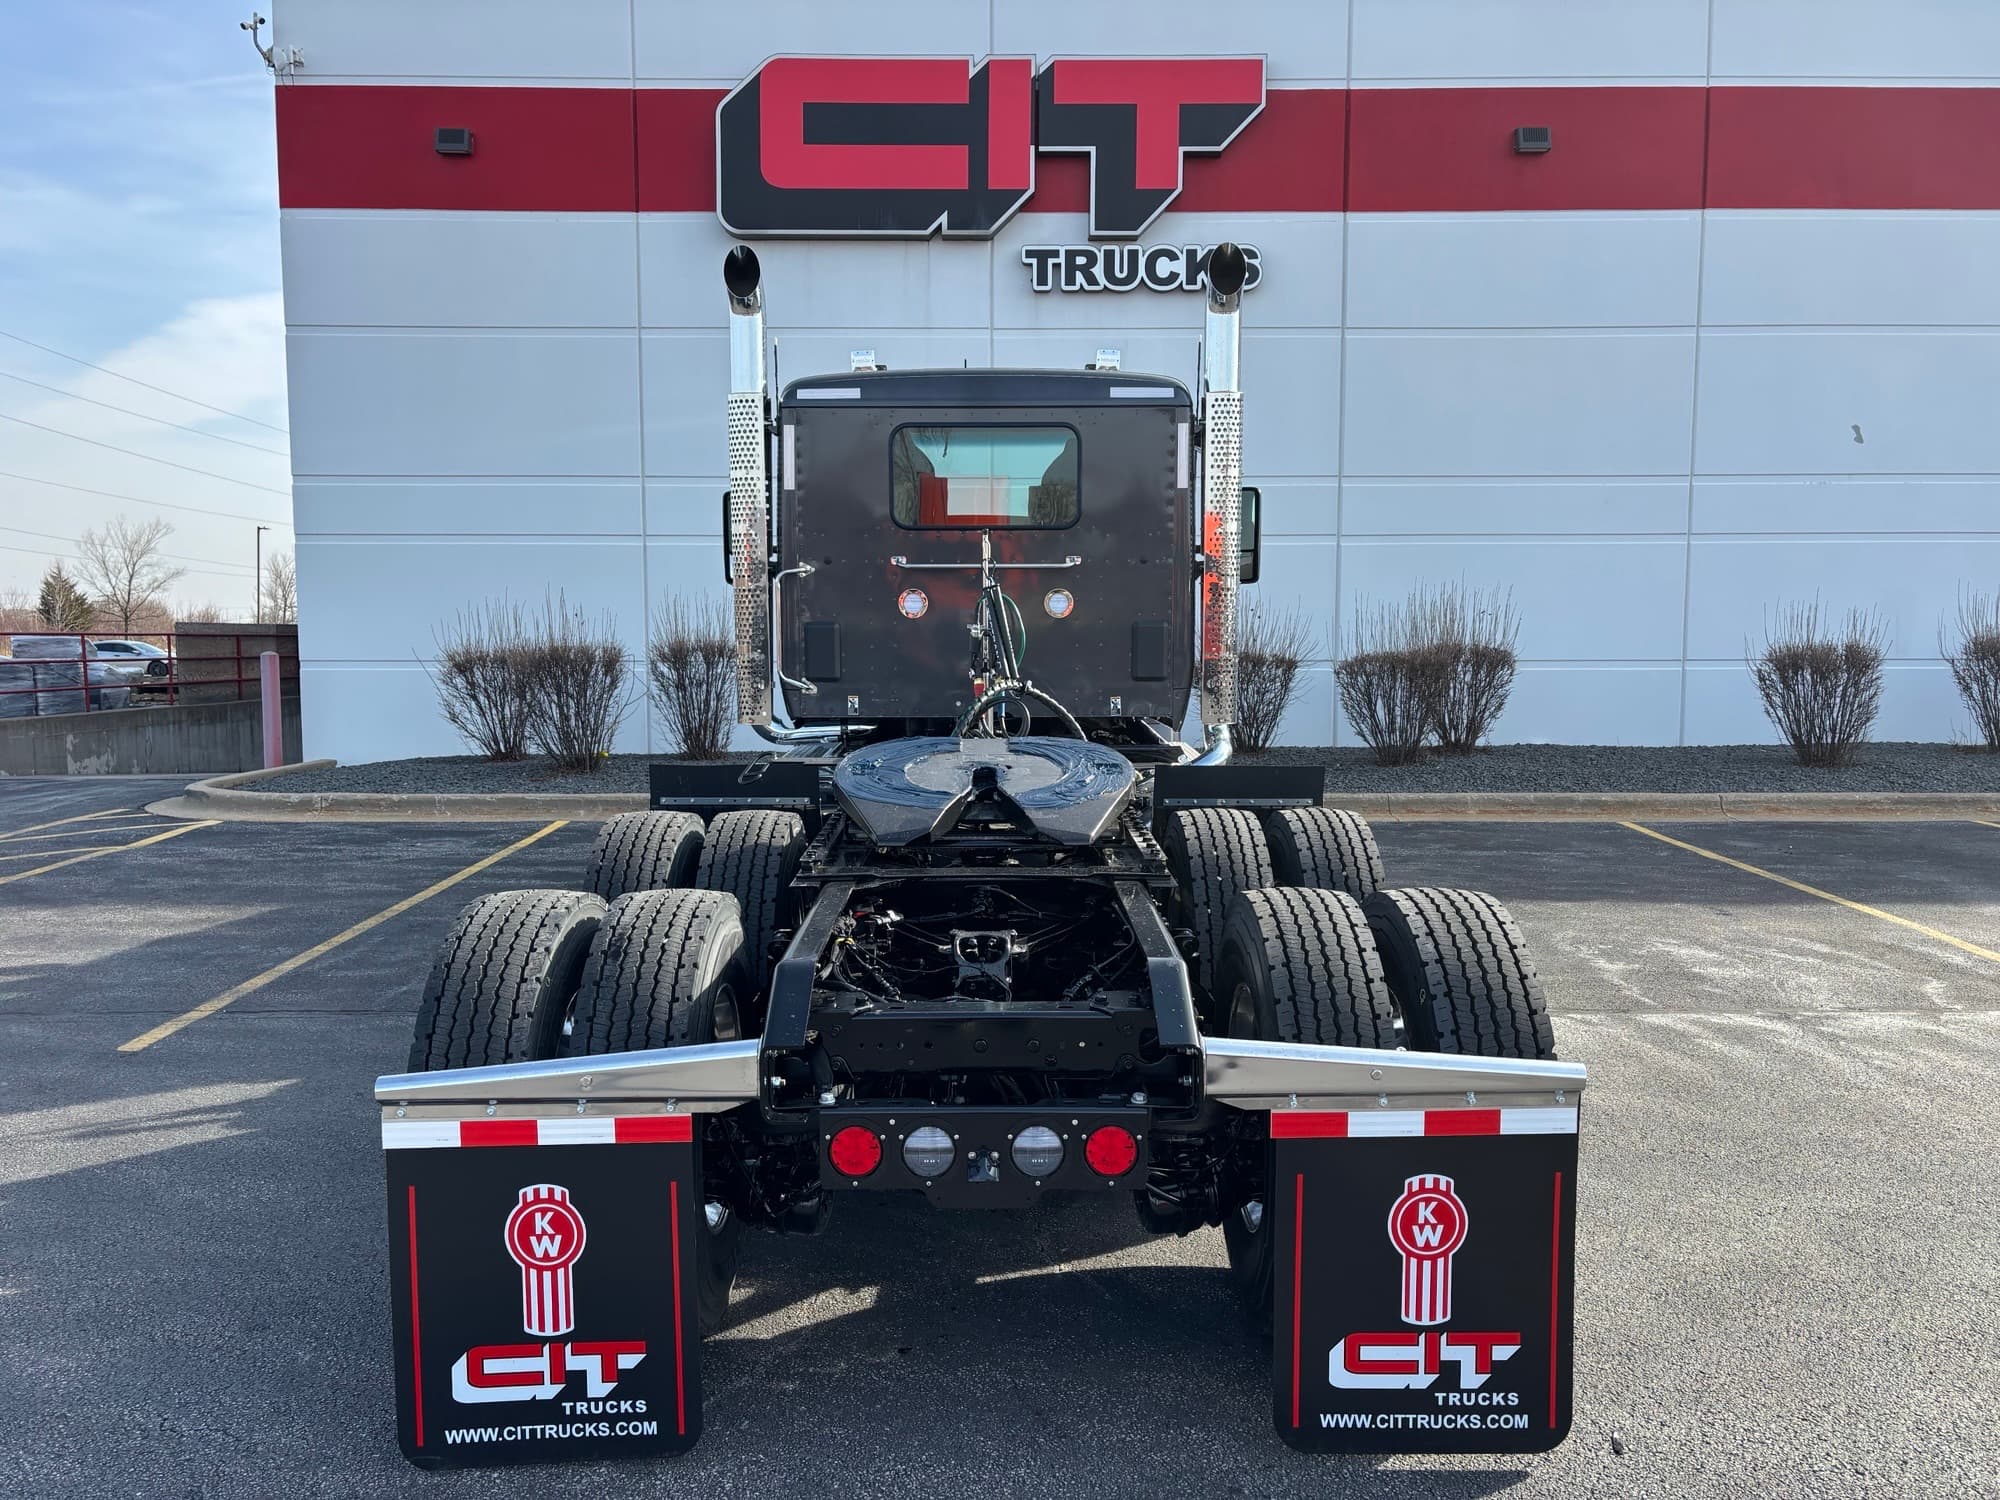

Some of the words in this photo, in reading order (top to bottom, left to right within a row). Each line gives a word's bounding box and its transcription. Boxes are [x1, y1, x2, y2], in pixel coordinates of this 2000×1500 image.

[717, 54, 1266, 238] CIT
[452, 1341, 647, 1403] CIT
[1329, 1332, 1522, 1389] CIT
[563, 1400, 647, 1415] TRUCKS
[1435, 1392, 1519, 1406] TRUCKS
[446, 1421, 658, 1444] WWW.CITTRUCKS.COM
[1320, 1414, 1529, 1429] WWW.CITTRUCKS.COM
